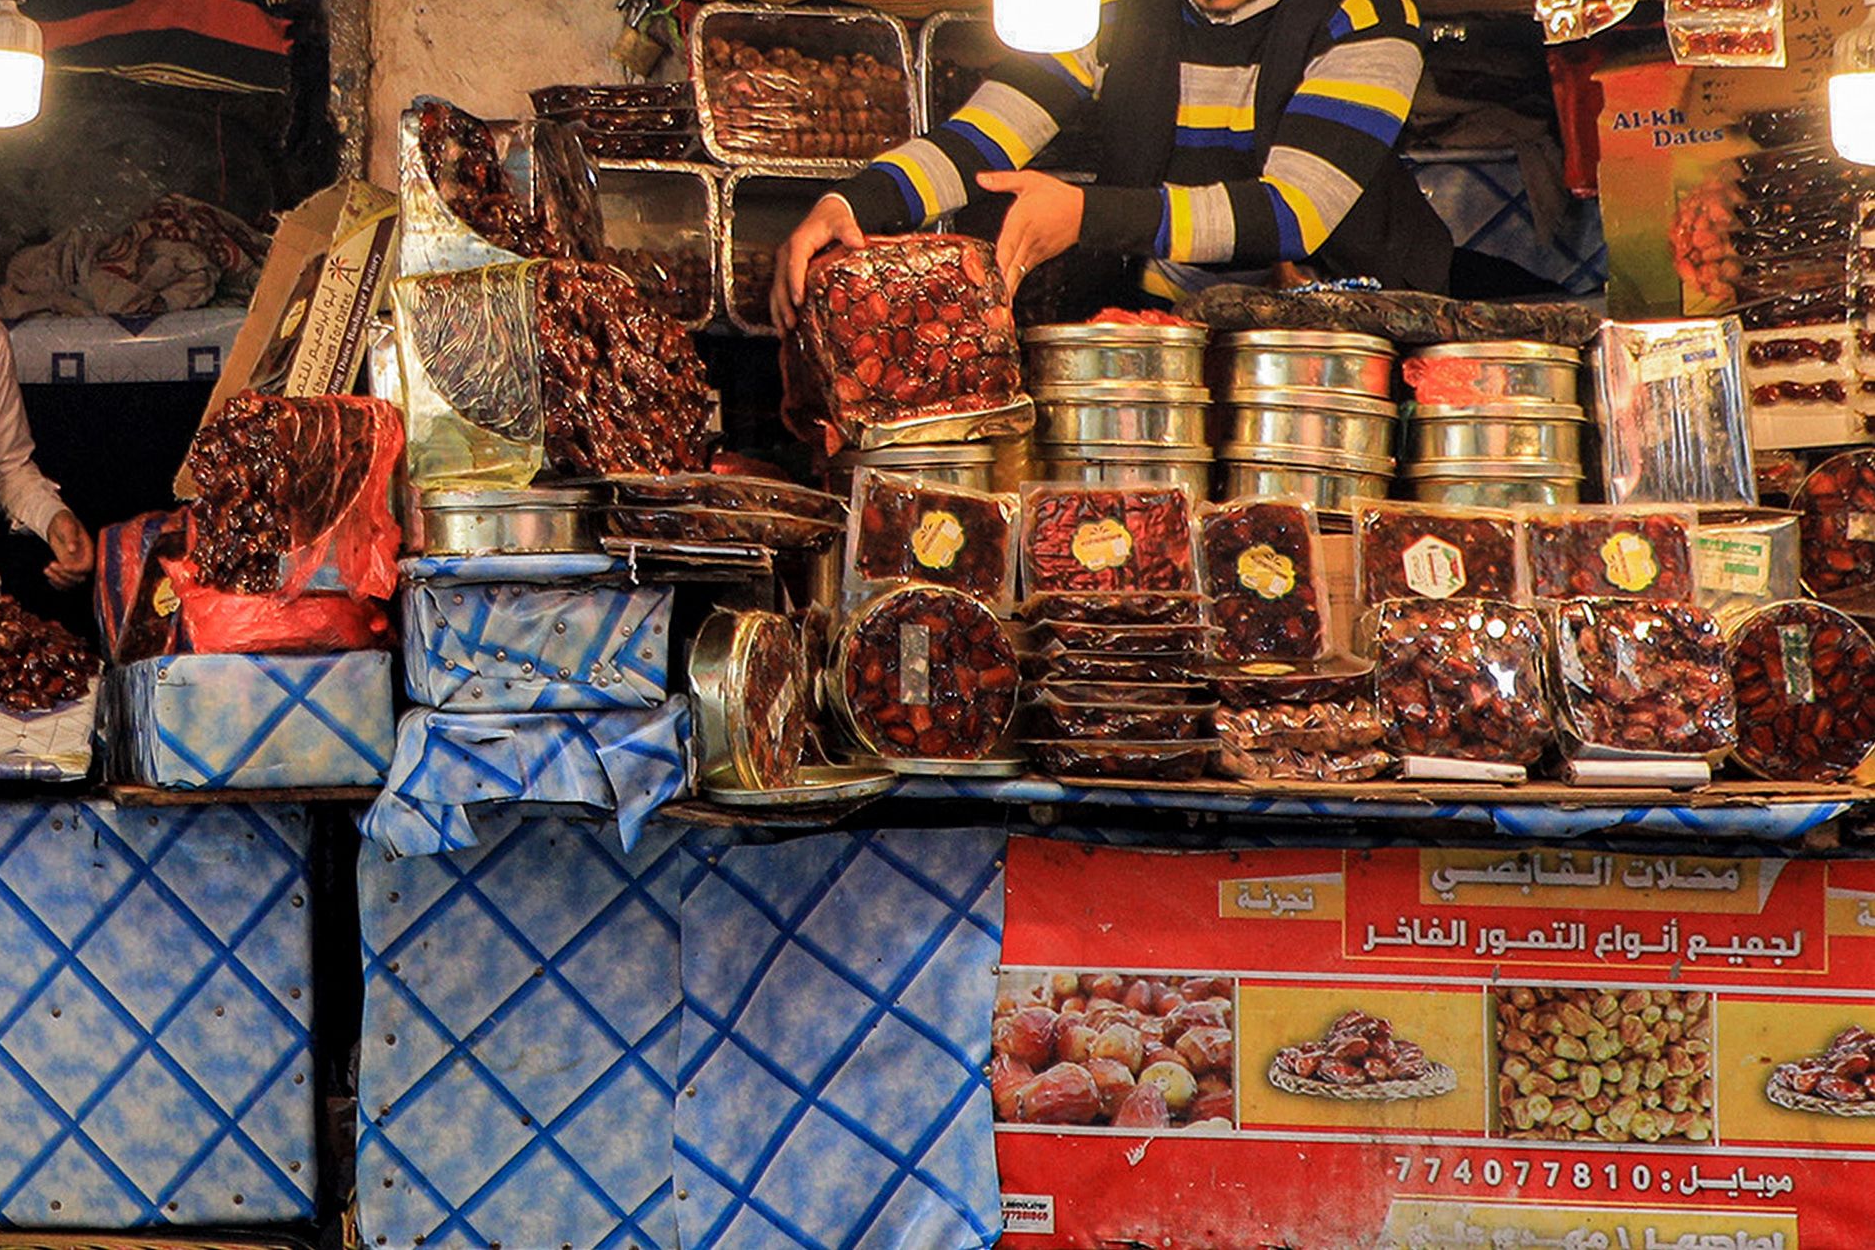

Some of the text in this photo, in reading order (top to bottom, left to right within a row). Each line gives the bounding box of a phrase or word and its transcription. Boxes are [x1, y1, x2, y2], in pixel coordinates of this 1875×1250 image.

[1612, 107, 1686, 131] Al-kh
[1653, 126, 1725, 148] Dates
[337, 347, 353, 372] Dates
[362, 254, 383, 292] Factory
[313, 292, 353, 395] Ebraheem For Dates
[1622, 859, 1741, 893] محلات
[1362, 916, 1804, 966] لجميع أنواع التمور الفاخر
[1393, 1156, 1652, 1193] 774077810
